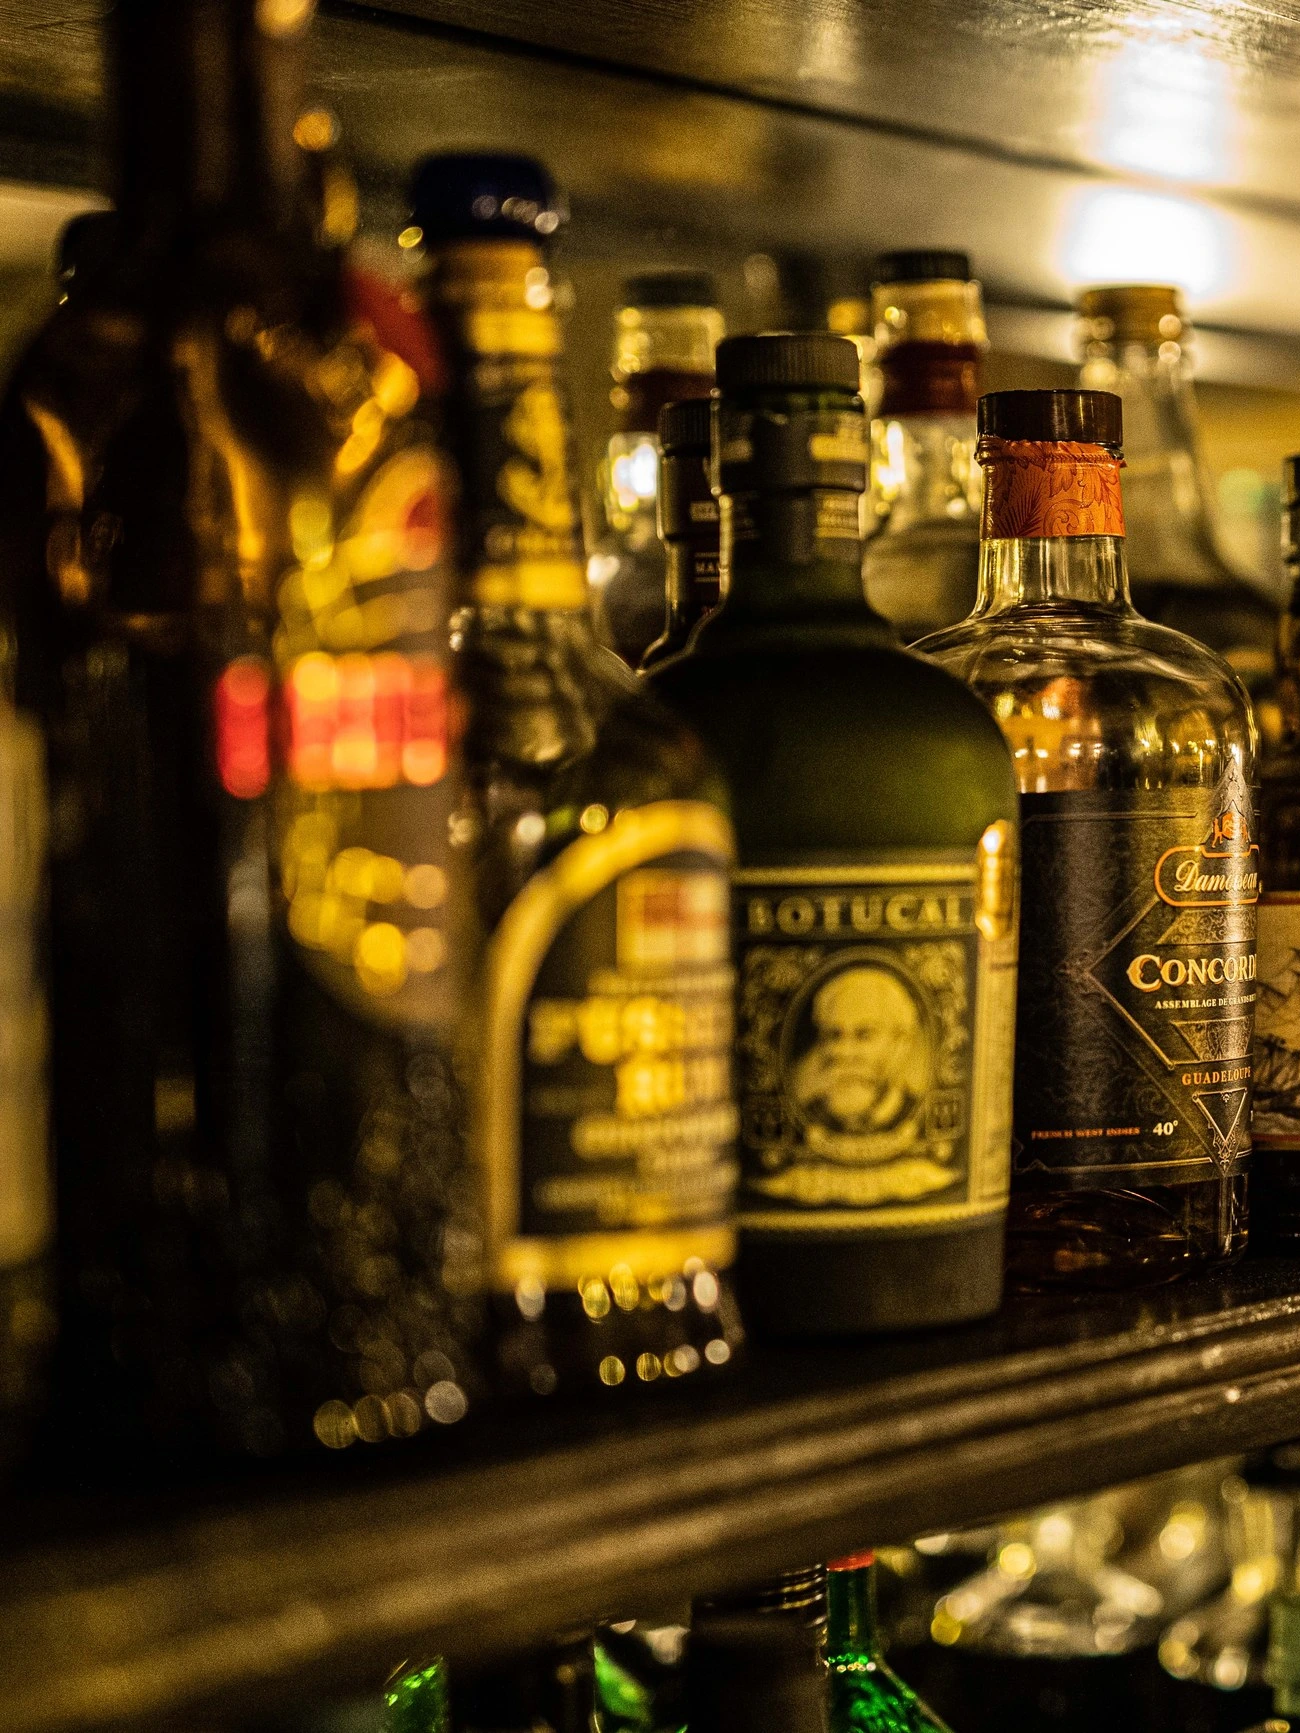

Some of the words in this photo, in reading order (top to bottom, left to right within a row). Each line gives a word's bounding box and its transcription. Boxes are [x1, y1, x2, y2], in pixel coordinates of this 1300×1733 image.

[1174, 860, 1258, 892] Damoseau
[1155, 998, 1217, 1009] ASSEMBLAGE
[1218, 997, 1228, 1006] DE
